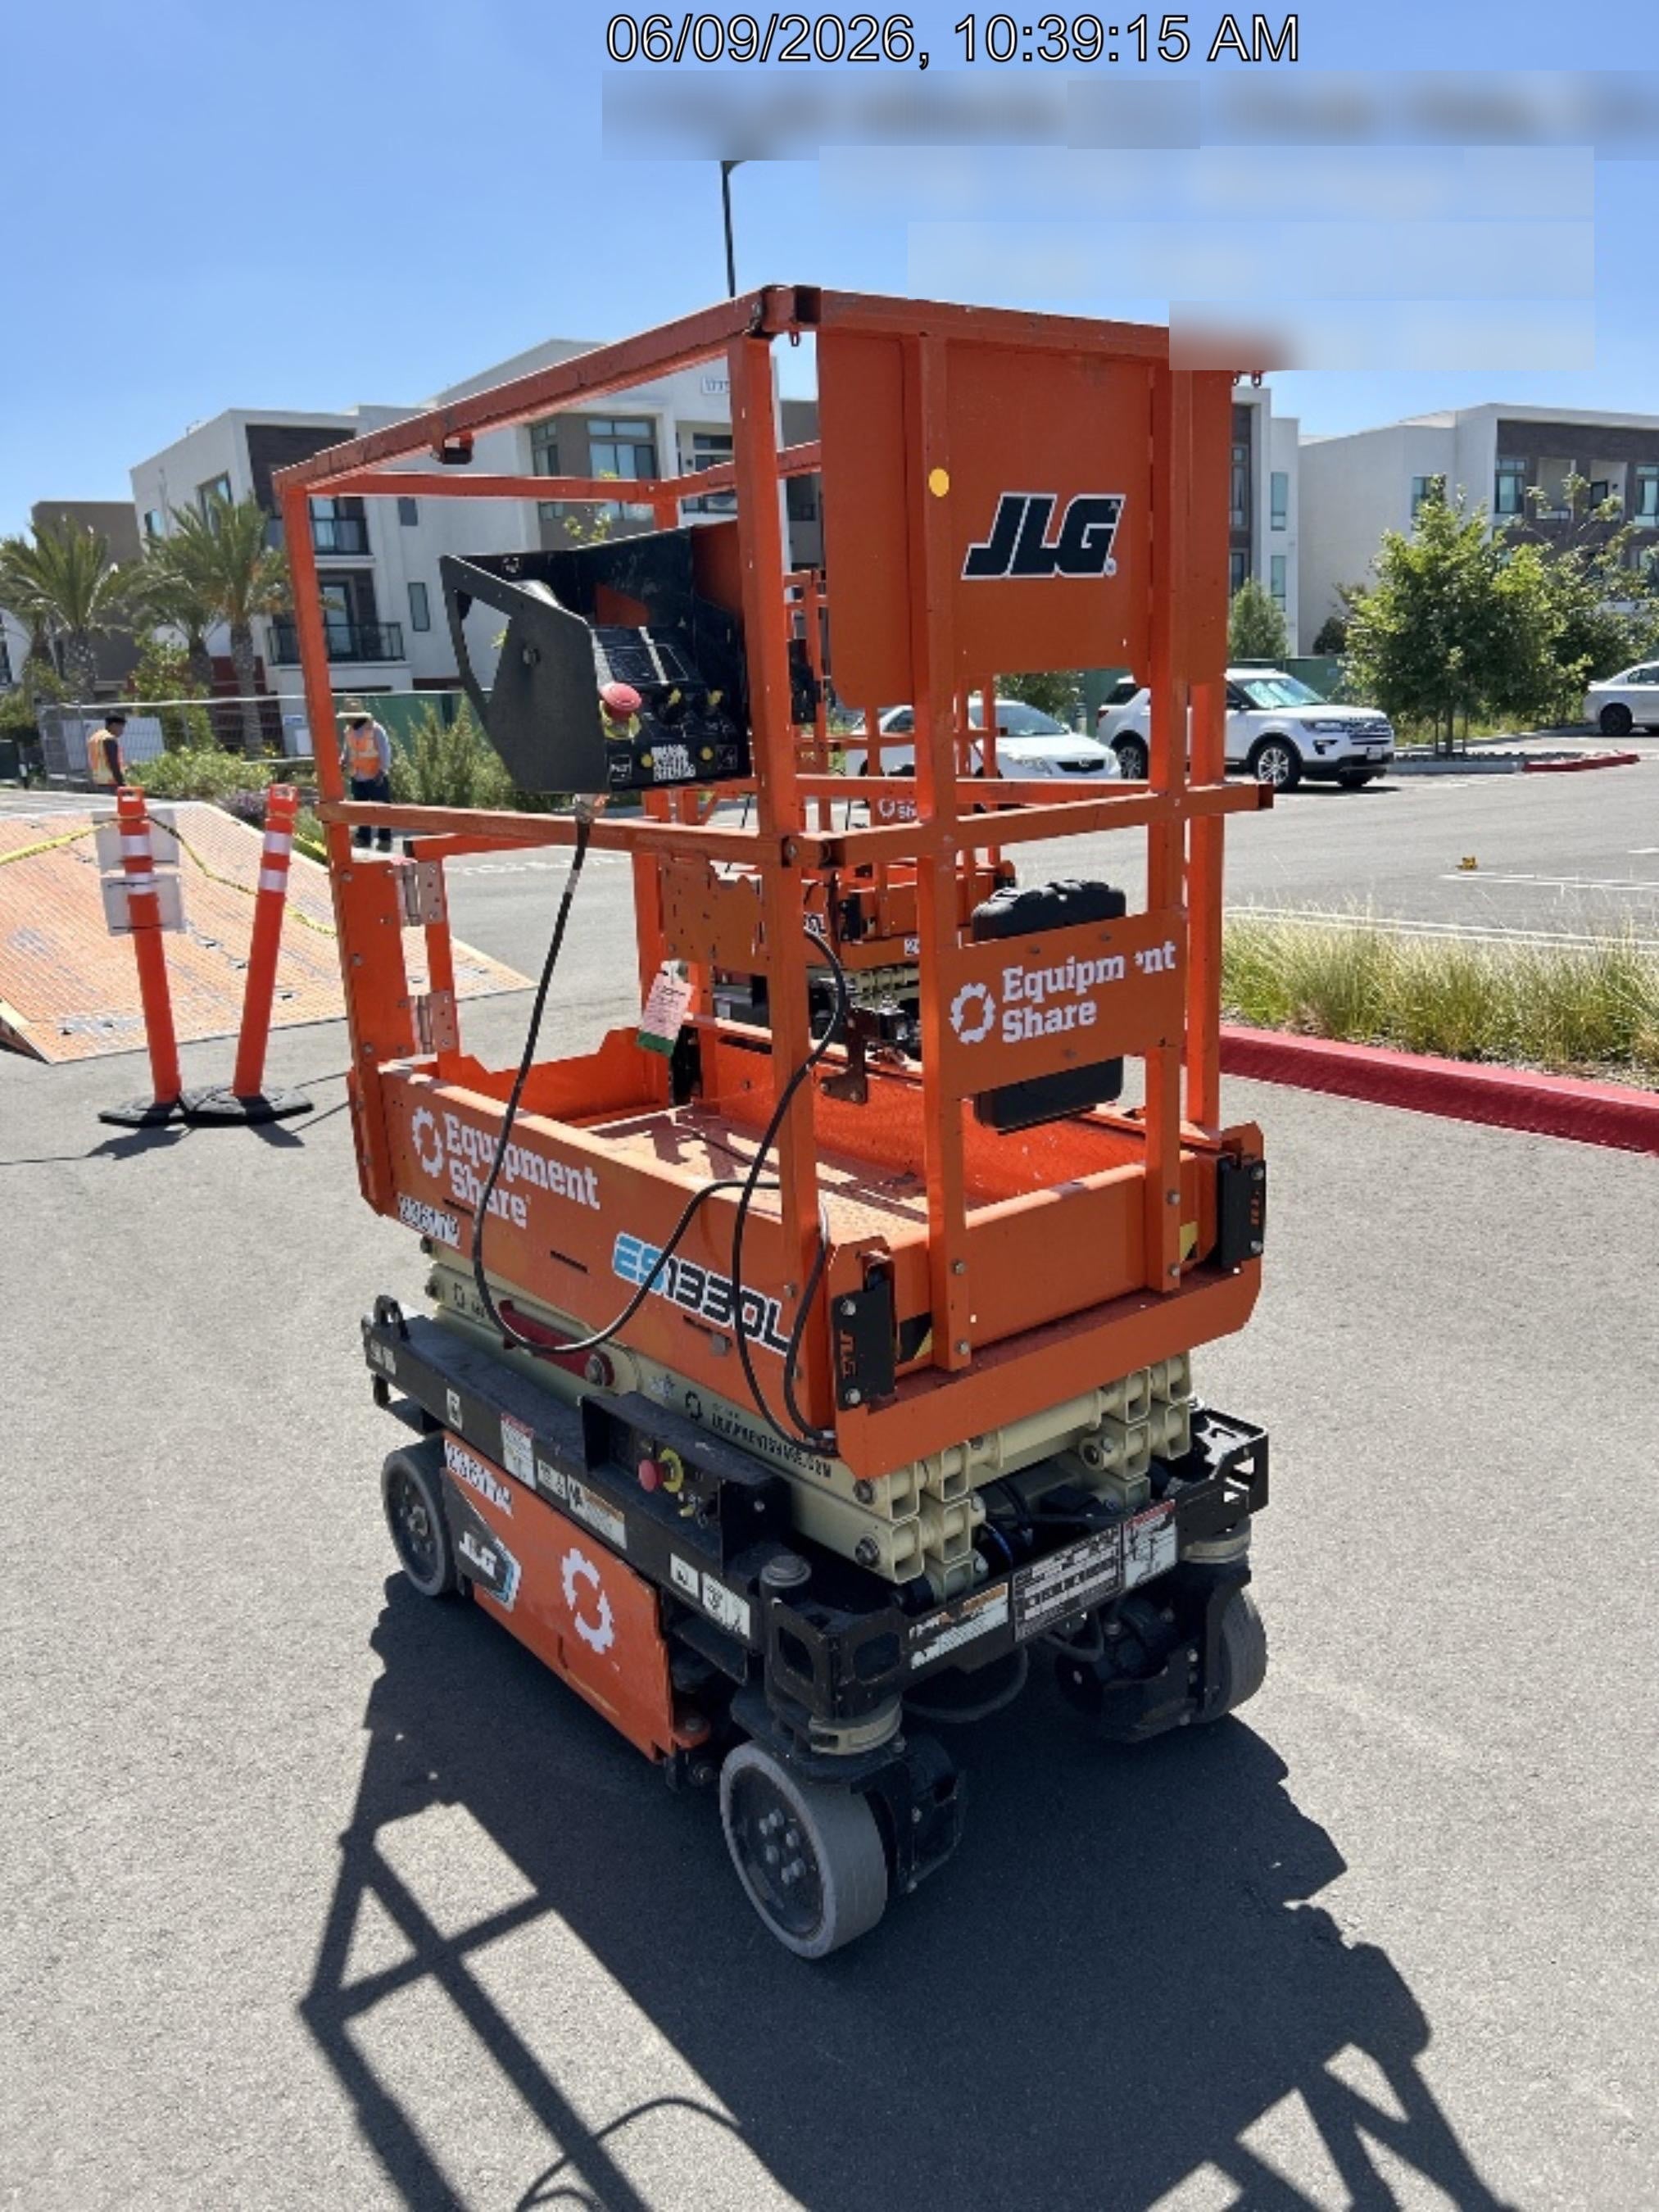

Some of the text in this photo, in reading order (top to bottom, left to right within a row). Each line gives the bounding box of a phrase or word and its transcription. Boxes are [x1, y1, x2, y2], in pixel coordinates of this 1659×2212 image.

[960, 492, 1126, 580] JLG
[1002, 1000, 1097, 1043] Share
[443, 1112, 601, 1210] Equpment
[449, 1158, 526, 1230] Share
[612, 1231, 790, 1358] ES1330L
